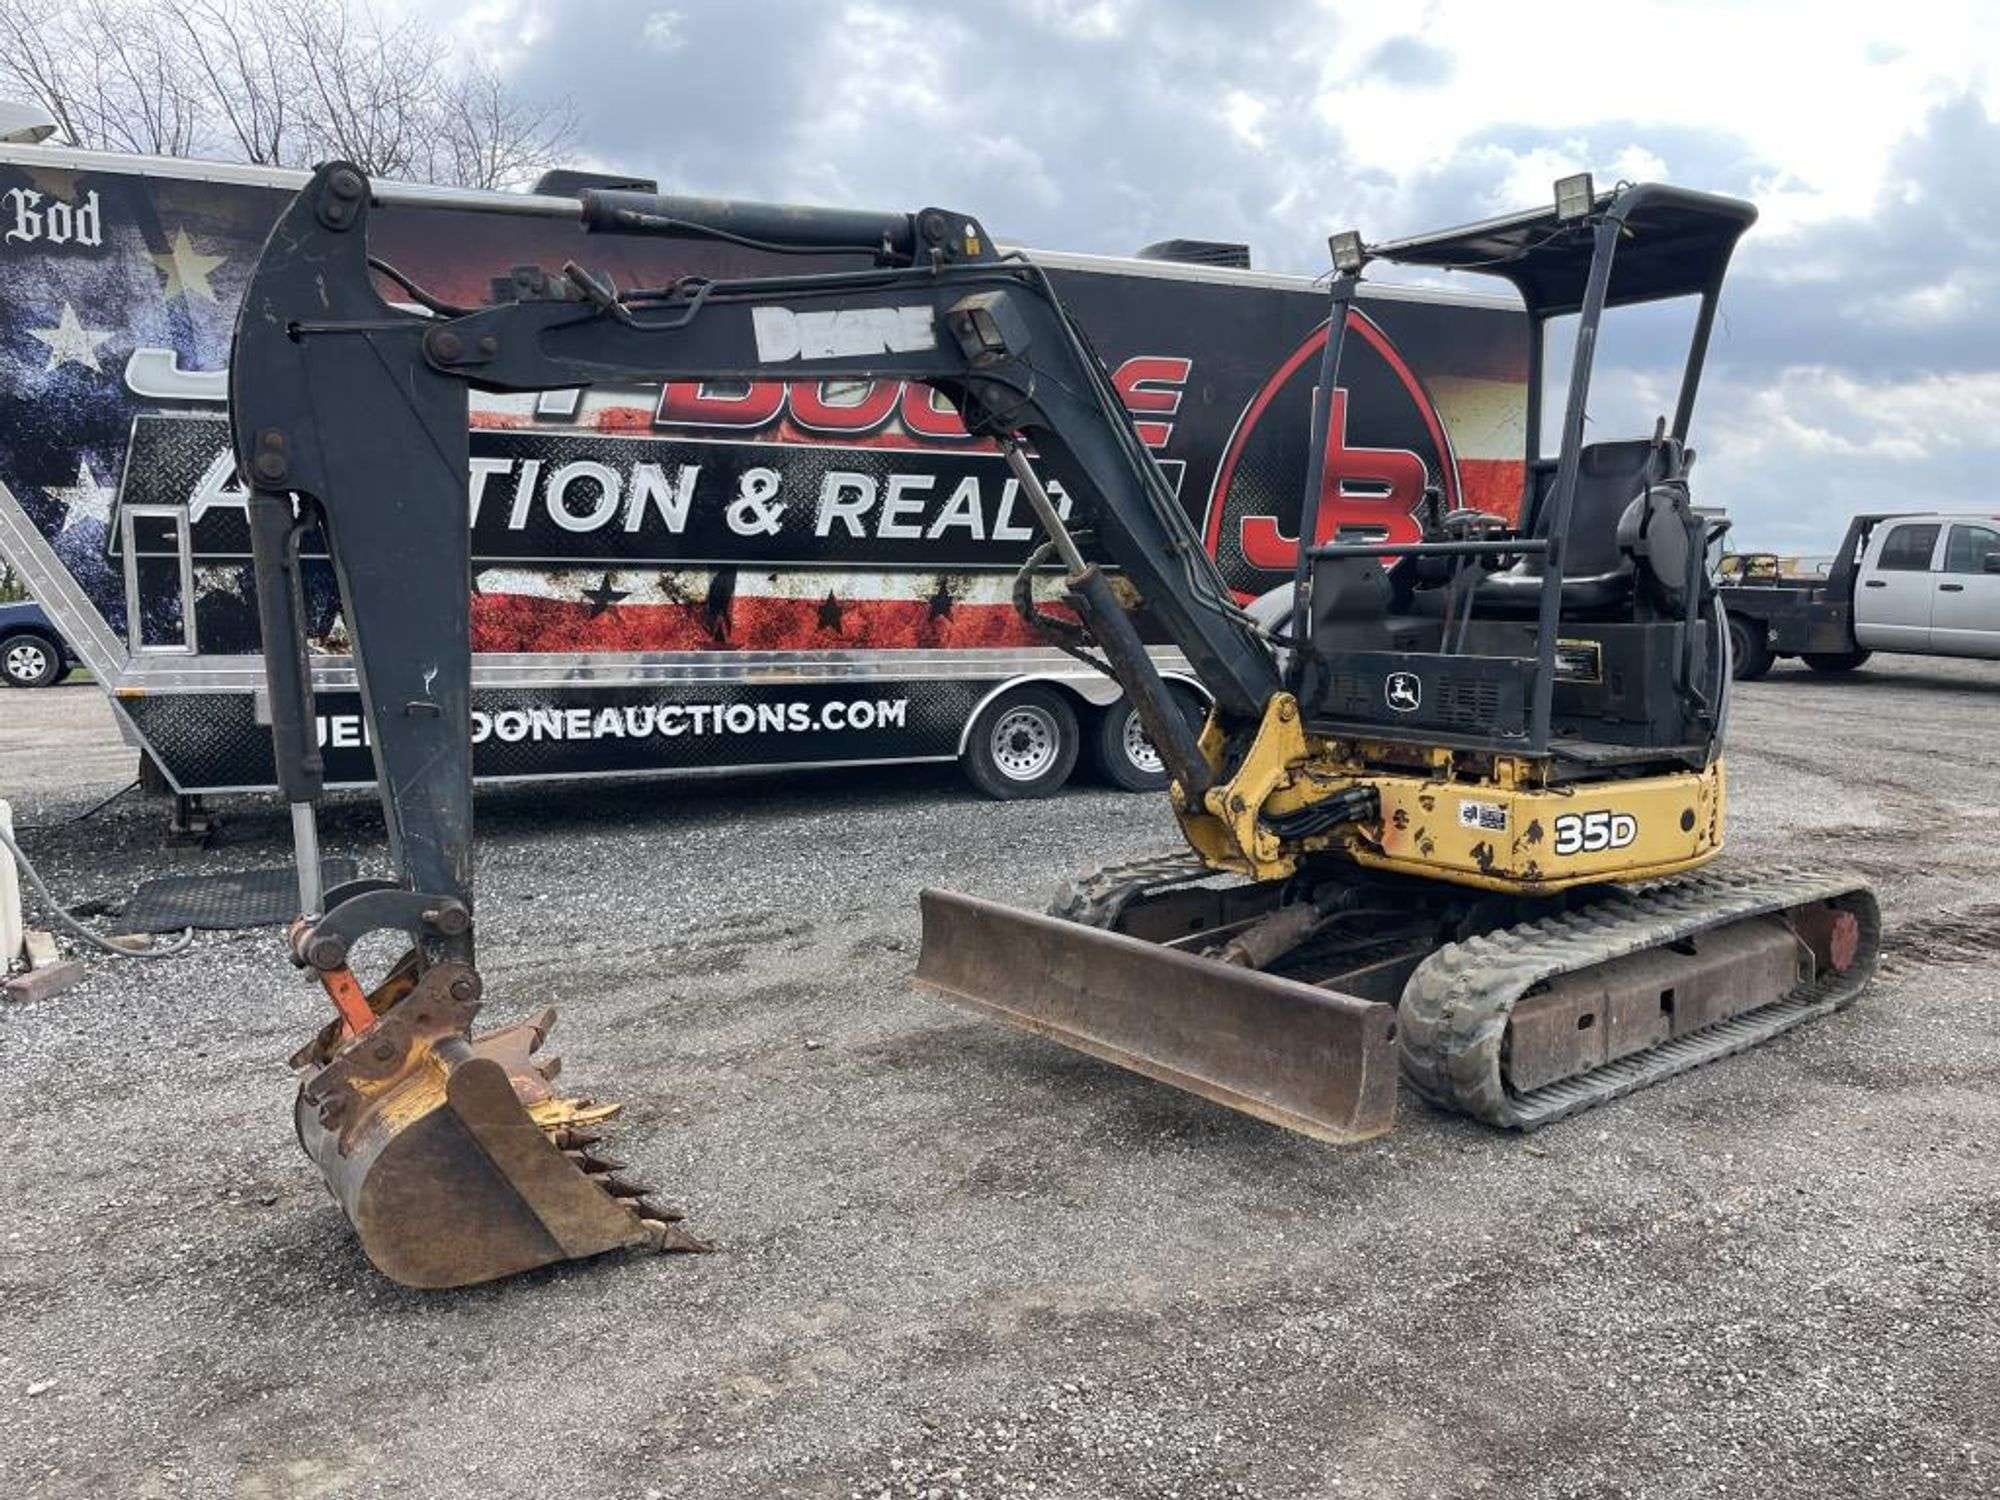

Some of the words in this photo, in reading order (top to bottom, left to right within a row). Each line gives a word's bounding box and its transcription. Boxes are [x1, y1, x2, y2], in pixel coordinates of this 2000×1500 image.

[190, 447, 701, 533] ATION
[727, 467, 787, 535] &
[1556, 810, 1637, 855] 35D
